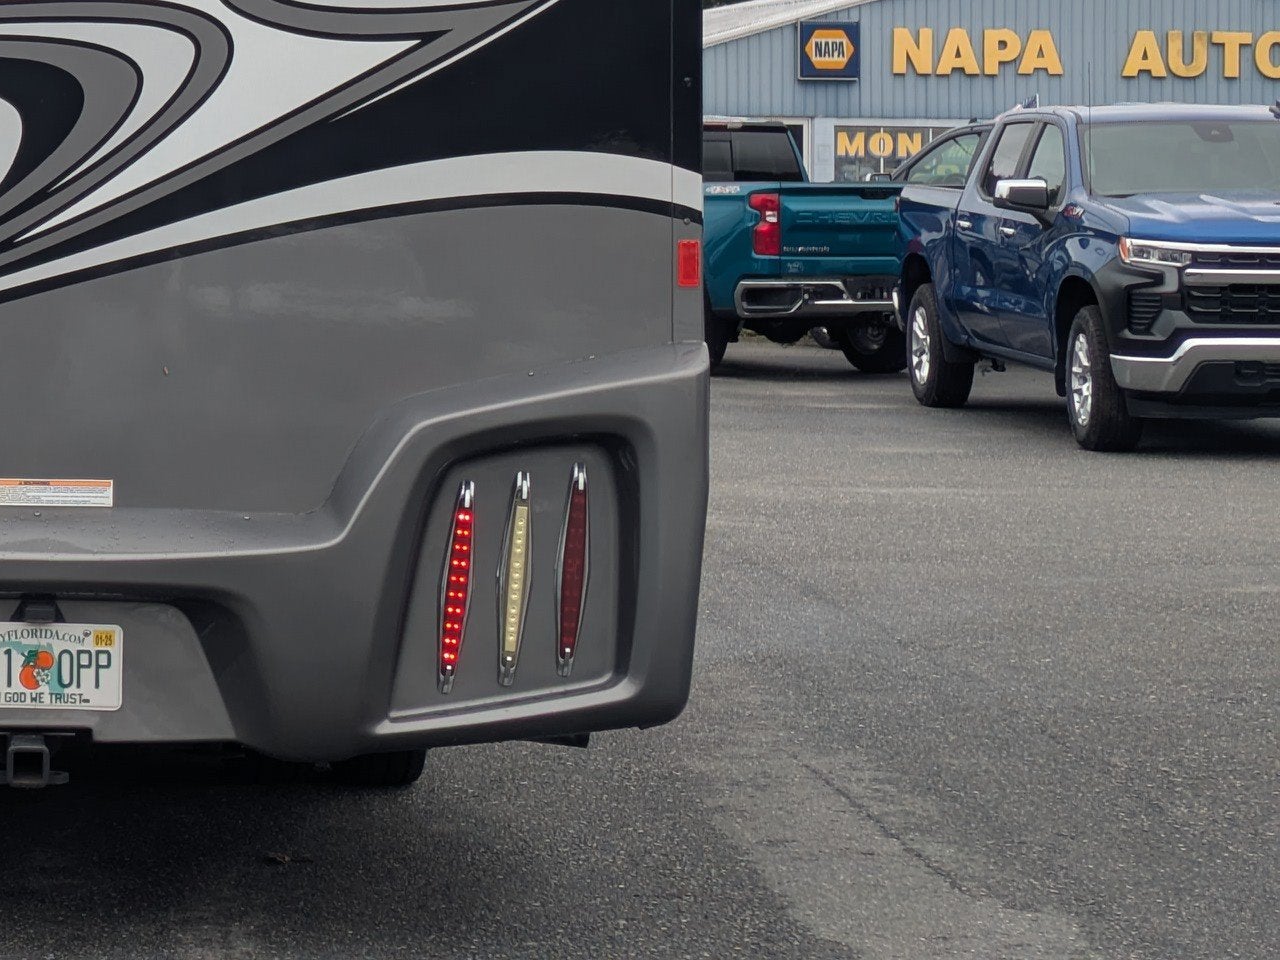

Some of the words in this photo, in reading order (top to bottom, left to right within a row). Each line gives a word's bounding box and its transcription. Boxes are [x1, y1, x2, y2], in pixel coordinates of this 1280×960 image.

[814, 41, 846, 59] NAPA
[892, 27, 1064, 75] NAPA
[1121, 29, 1280, 79] AUTO
[4, 692, 26, 703] GOD
[30, 692, 45, 703] WE
[48, 692, 83, 704] TRUST
